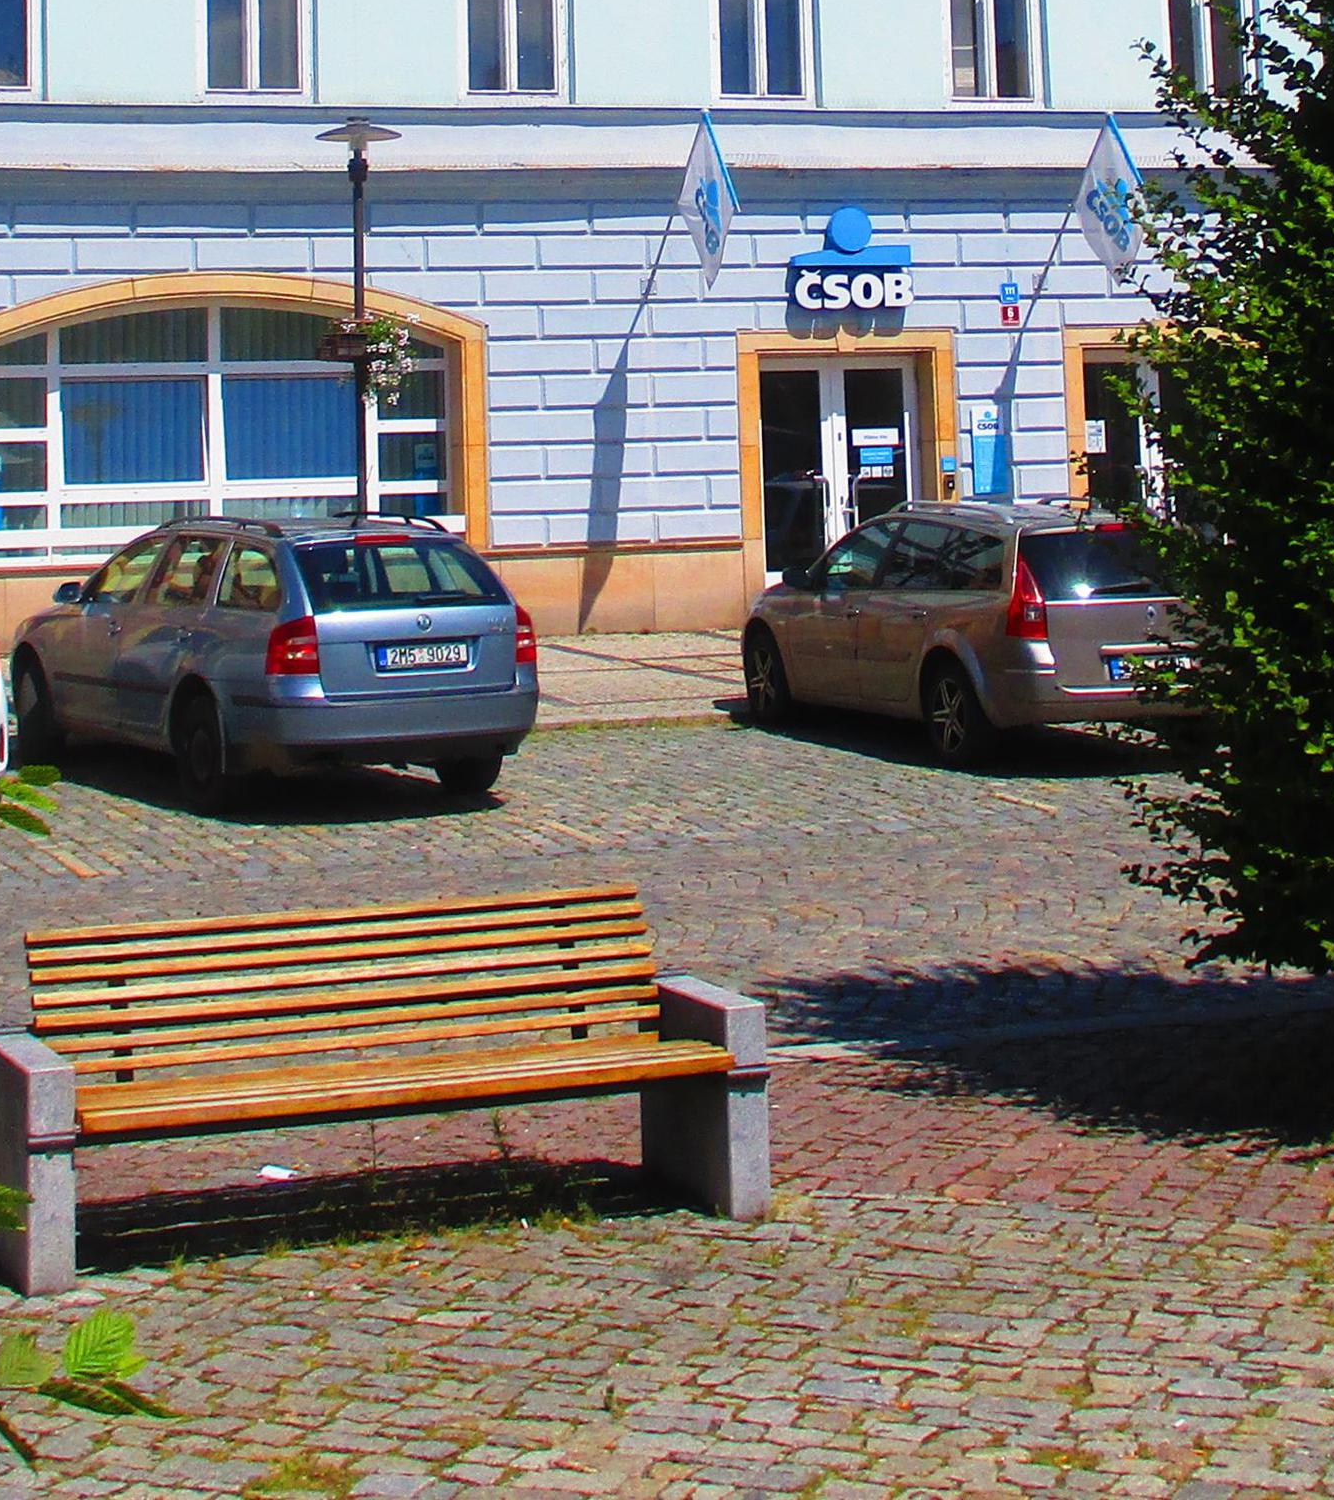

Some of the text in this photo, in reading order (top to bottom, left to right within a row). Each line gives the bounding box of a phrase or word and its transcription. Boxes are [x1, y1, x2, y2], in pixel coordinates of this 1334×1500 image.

[795, 269, 914, 310] ČSOB
[1007, 306, 1014, 318] 6
[390, 645, 461, 666] 2M5 9029
